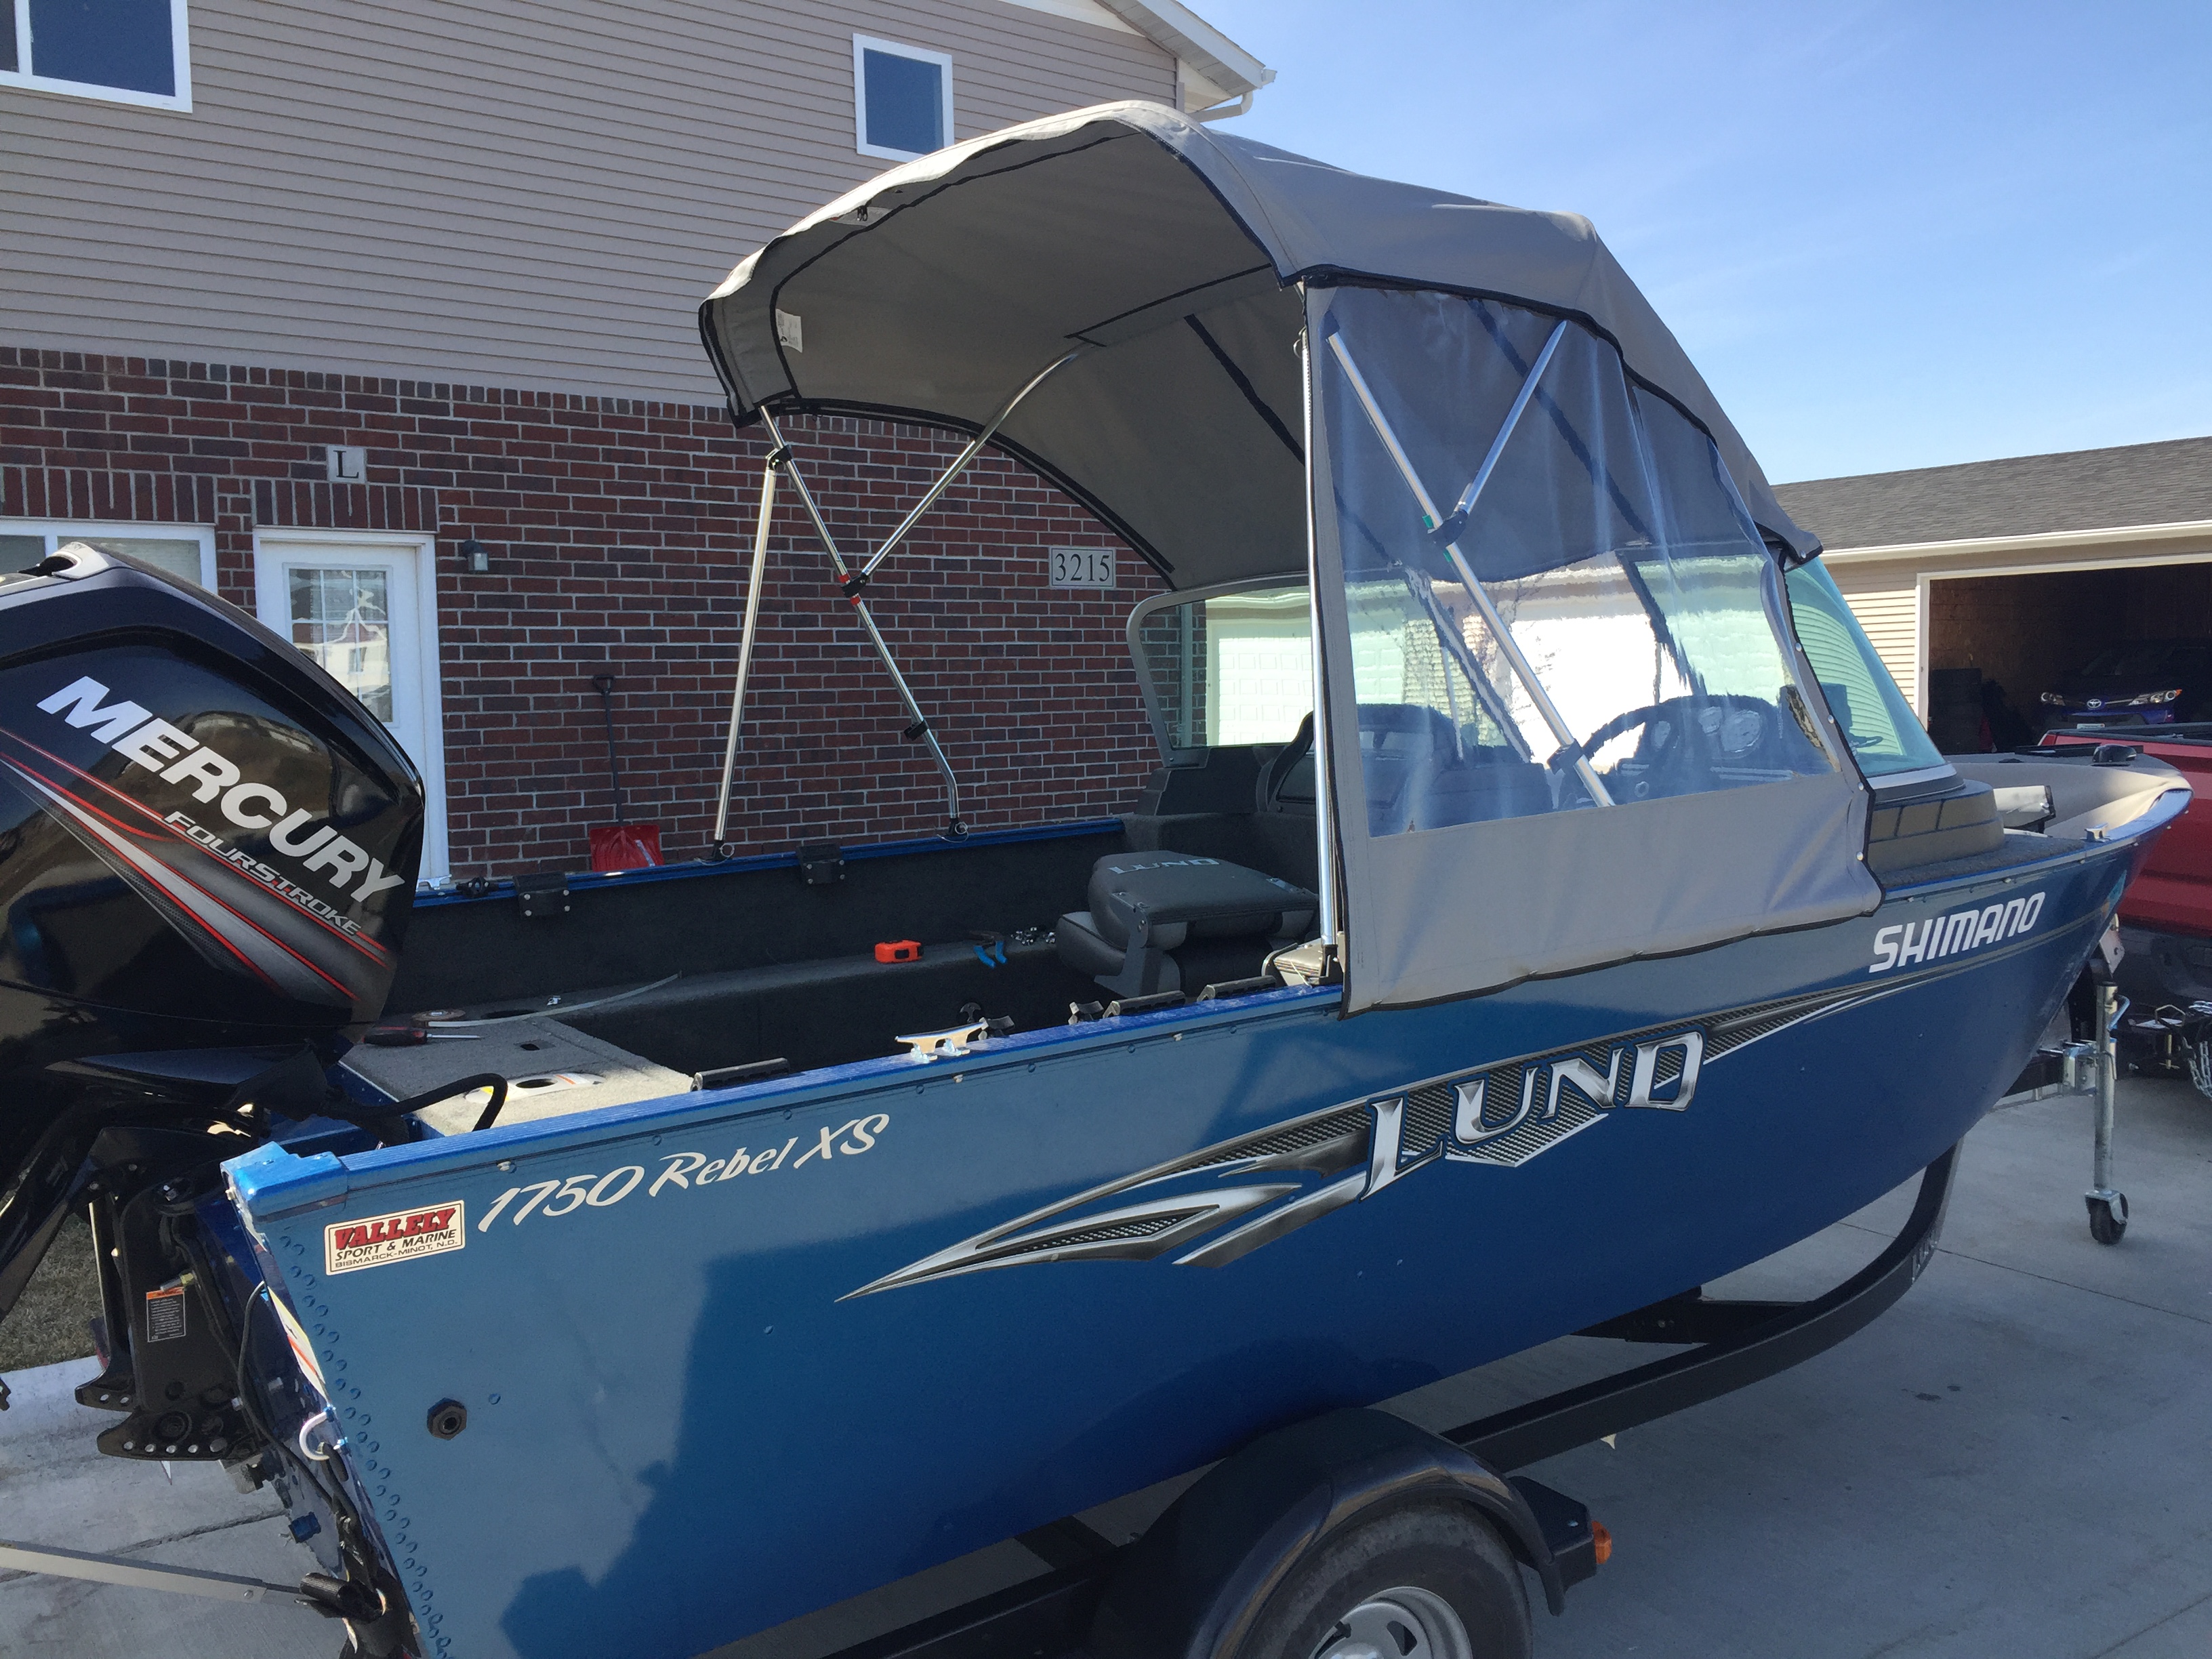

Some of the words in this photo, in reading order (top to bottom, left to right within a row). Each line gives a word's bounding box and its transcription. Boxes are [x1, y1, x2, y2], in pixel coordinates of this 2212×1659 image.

[333, 450, 359, 478] L
[1054, 553, 1110, 581] 3215
[37, 676, 405, 902] MERCURY
[164, 811, 362, 935] FOURSTROKE
[1107, 858, 1220, 874] LUND
[1868, 891, 2046, 973] SHIMANO
[1359, 1031, 1704, 1204] LUND
[478, 1166, 644, 1233] 1750
[649, 1136, 799, 1197] Rebel
[794, 1113, 890, 1169] XS
[334, 1208, 456, 1250] VALLELY
[335, 1244, 382, 1261] SPORT
[387, 1242, 396, 1250] &
[402, 1229, 457, 1248] MARINE
[335, 1244, 433, 1267] BISMARCK-MINOT,
[436, 1239, 458, 1248] N.D.
